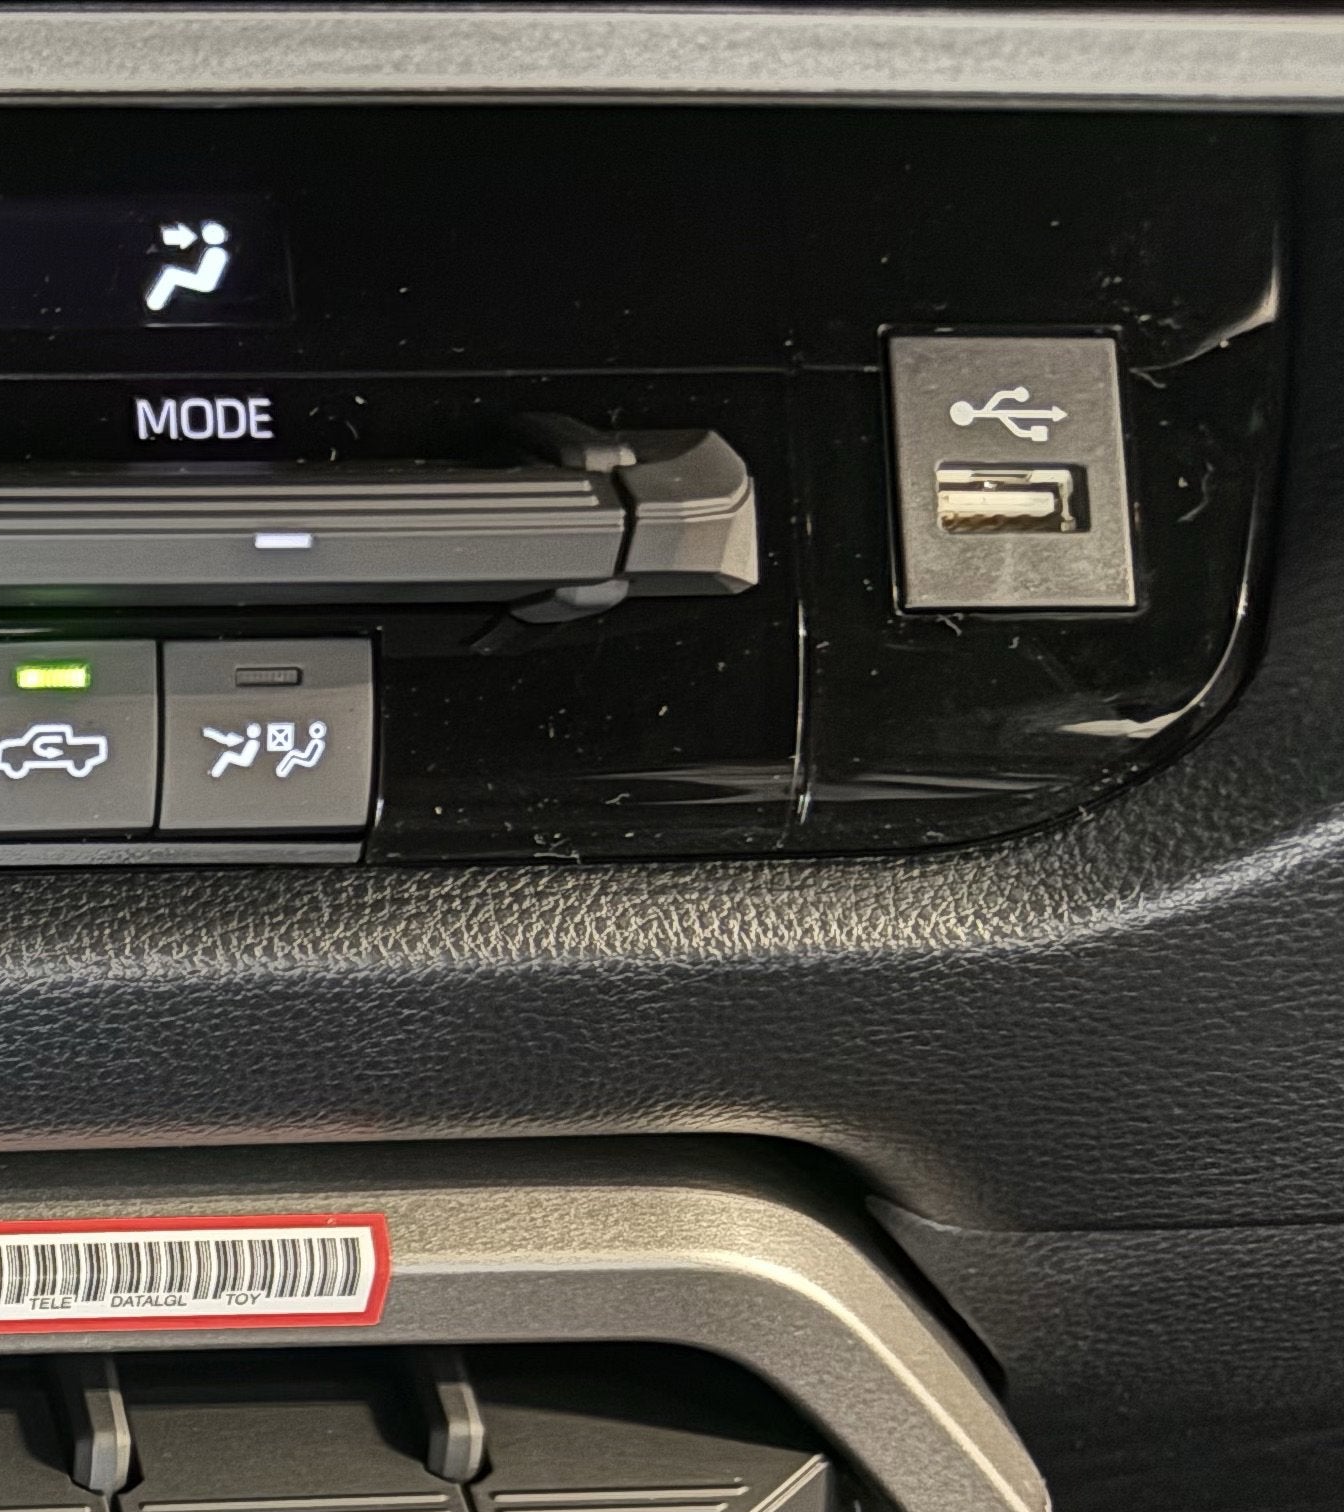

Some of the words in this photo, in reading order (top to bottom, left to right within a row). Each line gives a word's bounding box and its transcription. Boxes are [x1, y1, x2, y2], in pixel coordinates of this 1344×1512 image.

[135, 397, 275, 440] MODE
[29, 1296, 73, 1311] TELE
[110, 1294, 187, 1309] DATALGL
[226, 1292, 262, 1306] TOY
